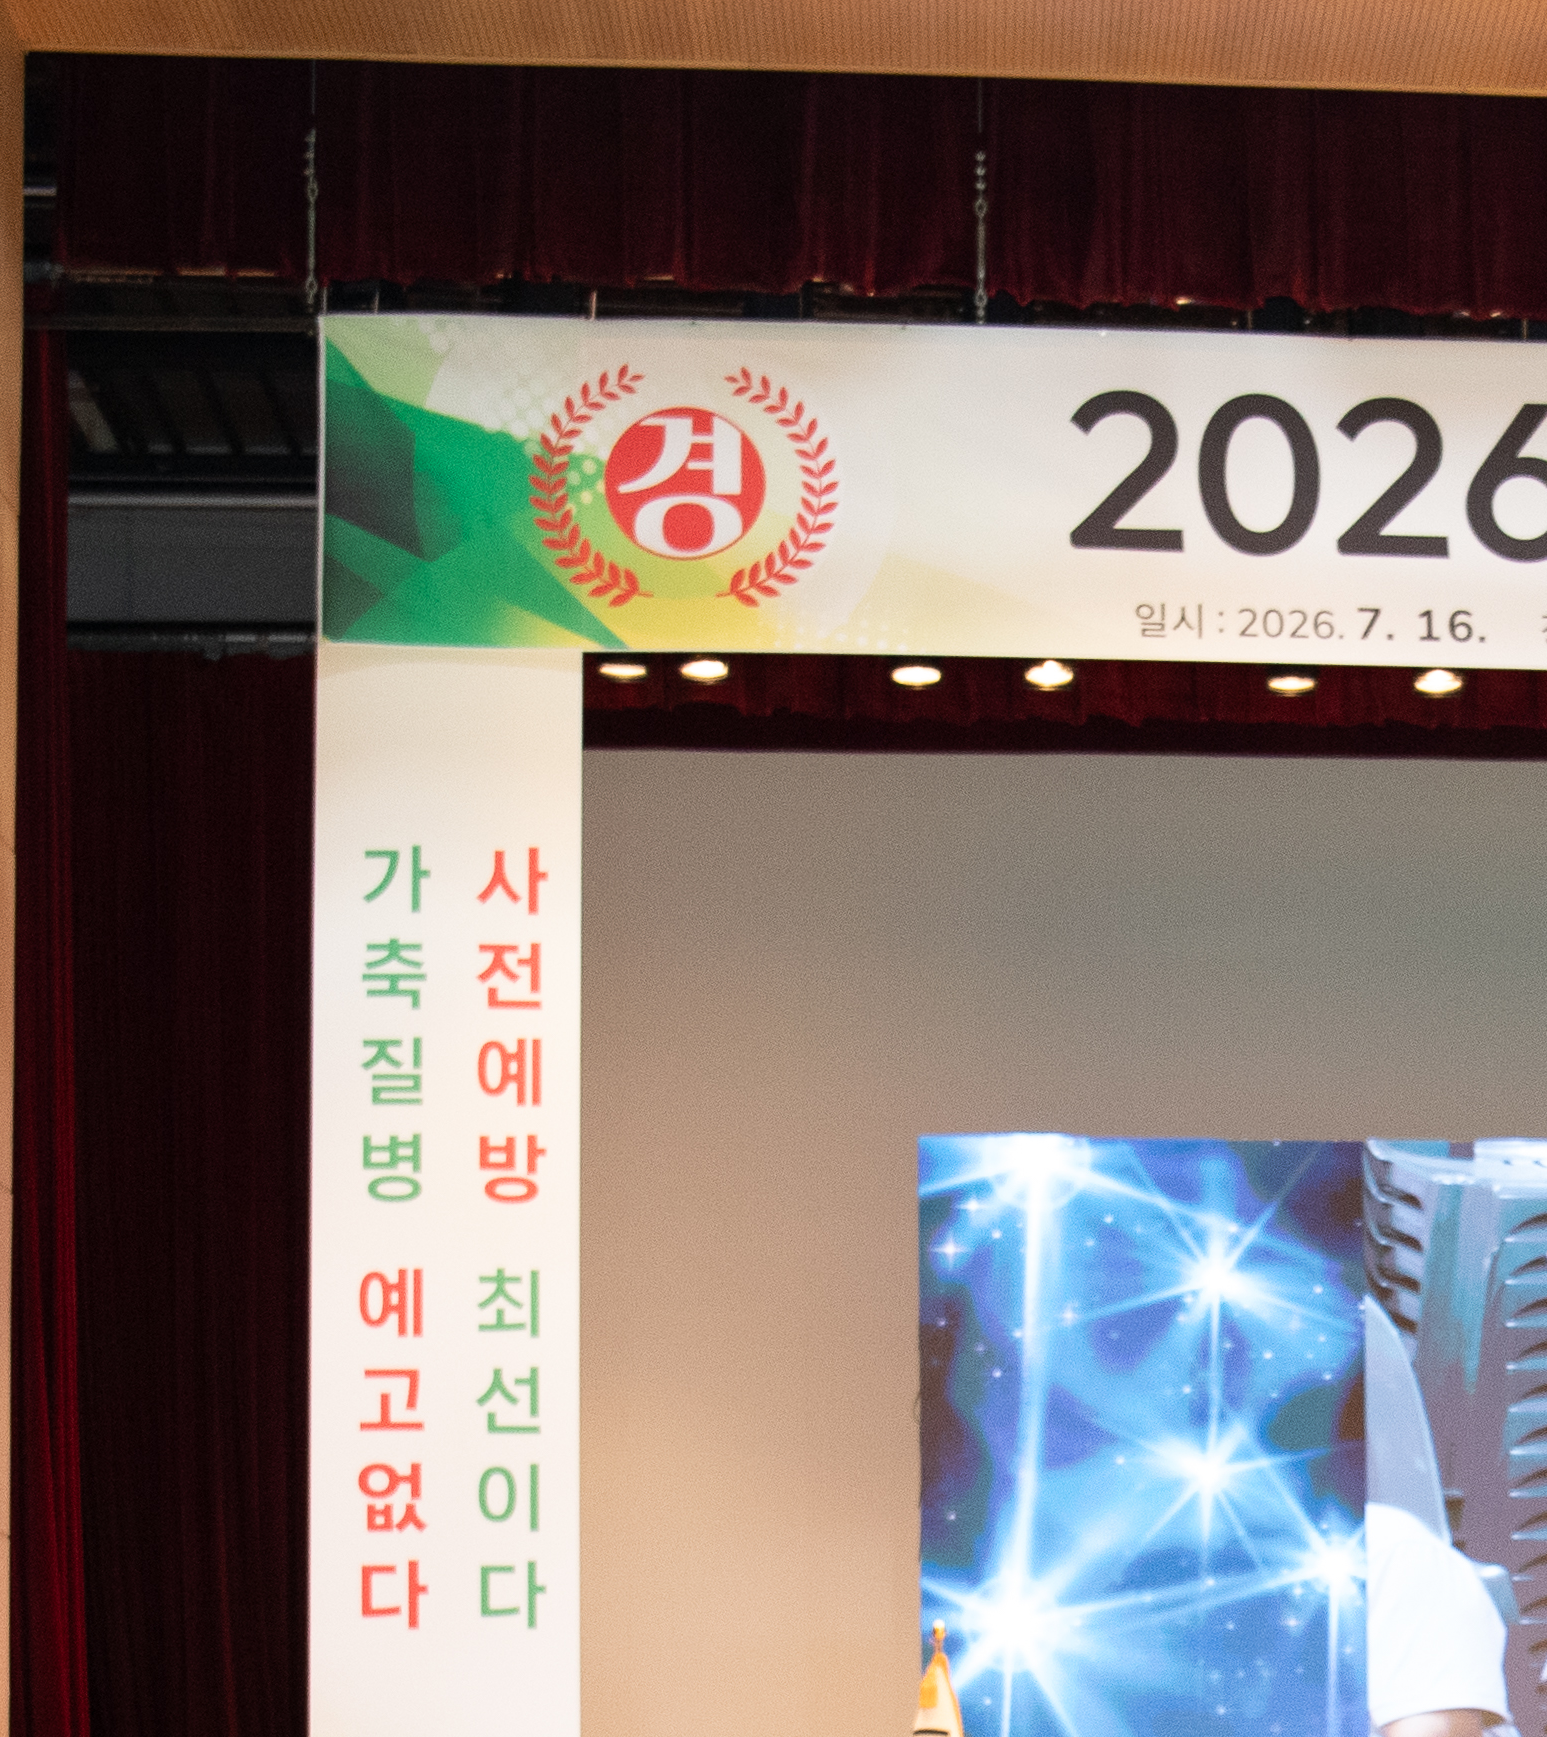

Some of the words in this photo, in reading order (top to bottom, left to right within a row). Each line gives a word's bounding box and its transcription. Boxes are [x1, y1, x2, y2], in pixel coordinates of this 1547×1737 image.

[616, 414, 744, 557] 경
[1238, 607, 1345, 640] 2026.
[1358, 607, 1395, 641] 7.
[1419, 609, 1487, 643] 16.
[360, 845, 432, 1204] 가축질병
[476, 845, 550, 1204] 사전예방
[356, 1267, 429, 1630] 예고없다
[476, 1267, 548, 1630] 최선이다
